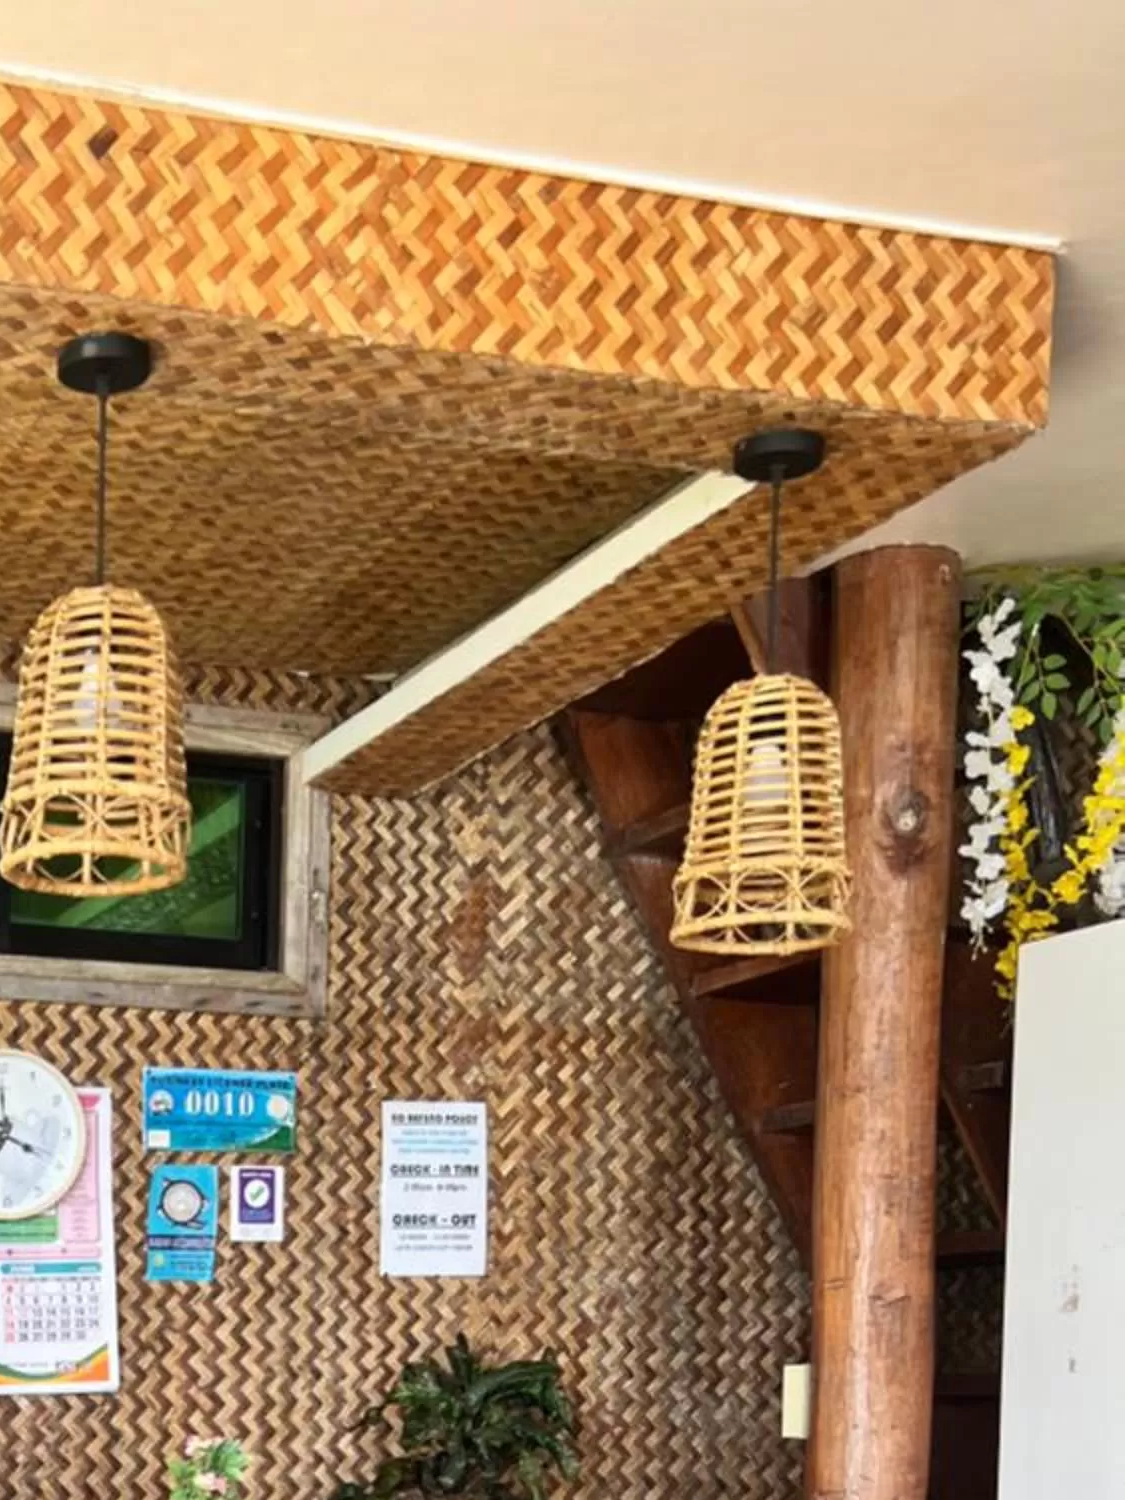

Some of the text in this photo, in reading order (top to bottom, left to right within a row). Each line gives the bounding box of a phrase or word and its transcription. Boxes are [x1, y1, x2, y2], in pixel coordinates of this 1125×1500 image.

[185, 1089, 254, 1117] 0010
[391, 1164, 431, 1177] CHECK
[453, 1164, 479, 1177] TIME
[392, 1213, 437, 1226] CHECK
[451, 1213, 476, 1226] OUT
